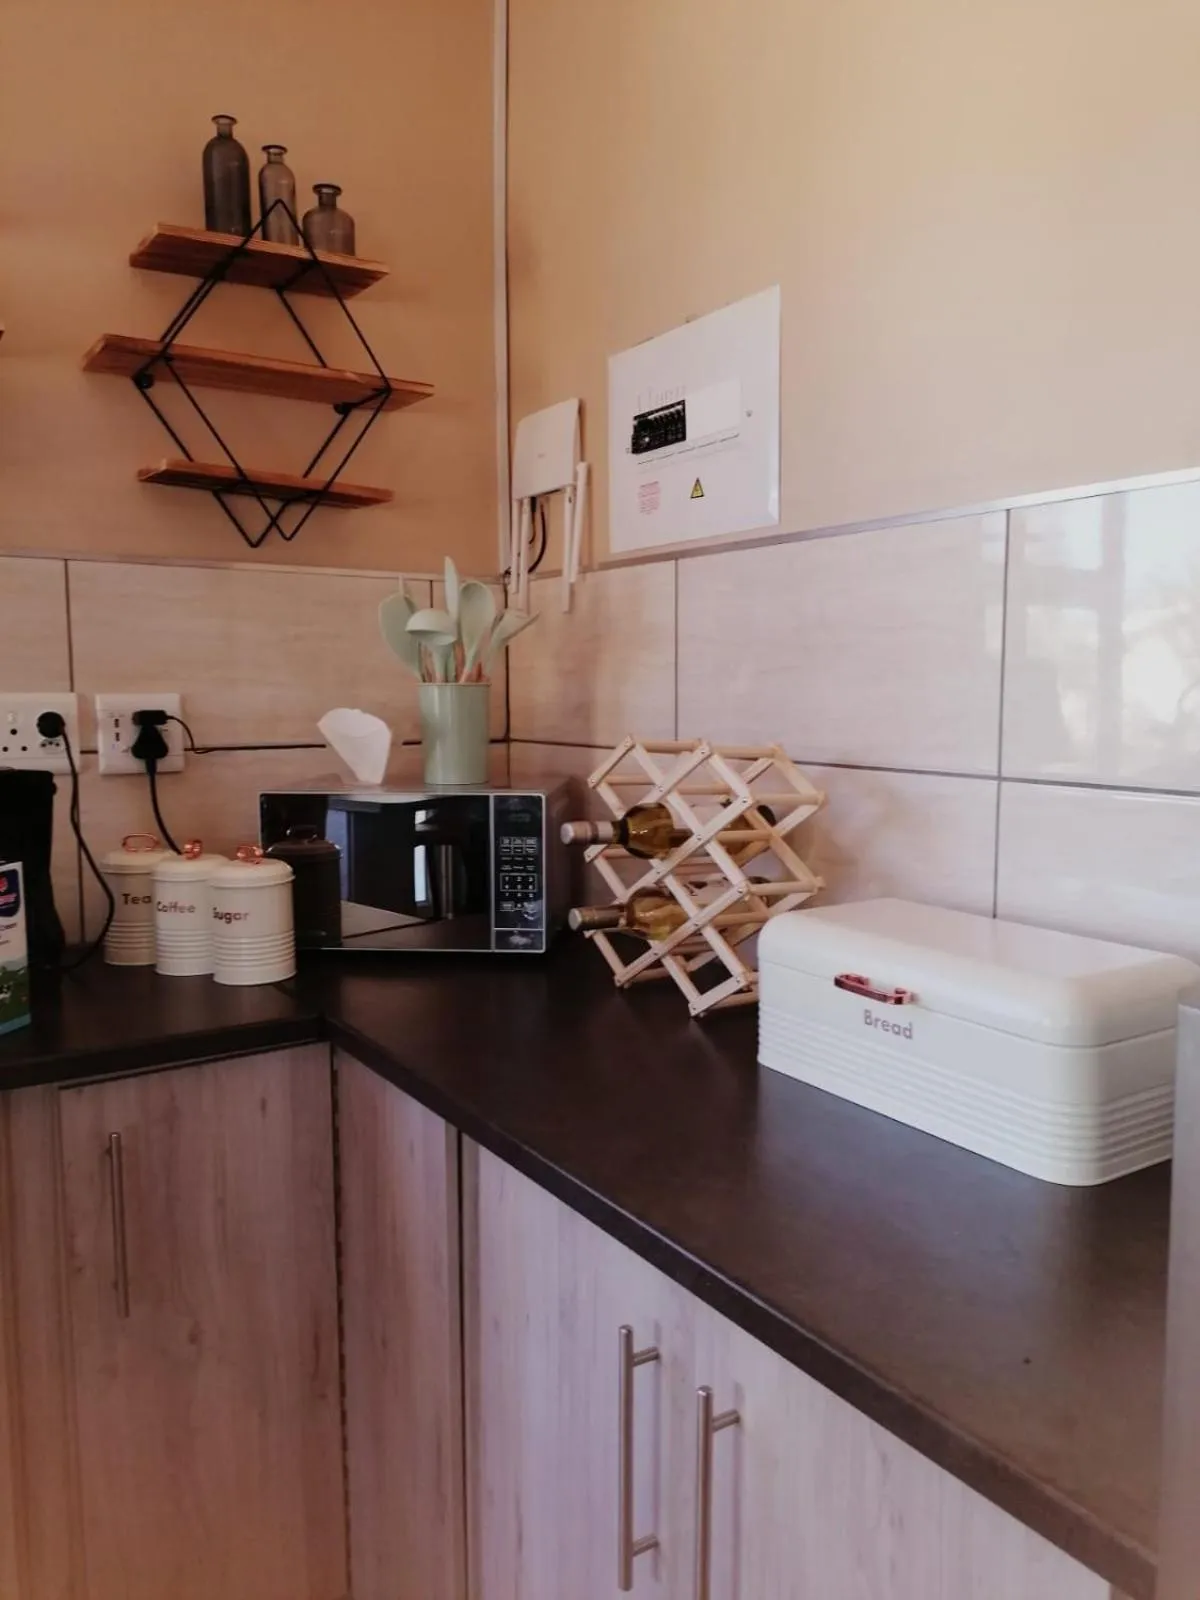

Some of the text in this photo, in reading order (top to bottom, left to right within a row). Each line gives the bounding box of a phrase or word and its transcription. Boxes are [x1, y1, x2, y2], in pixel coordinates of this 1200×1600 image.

[122, 893, 152, 905] Tea
[156, 901, 196, 914] Coffee
[212, 907, 249, 924] Sugar
[864, 1009, 913, 1039] Bread
